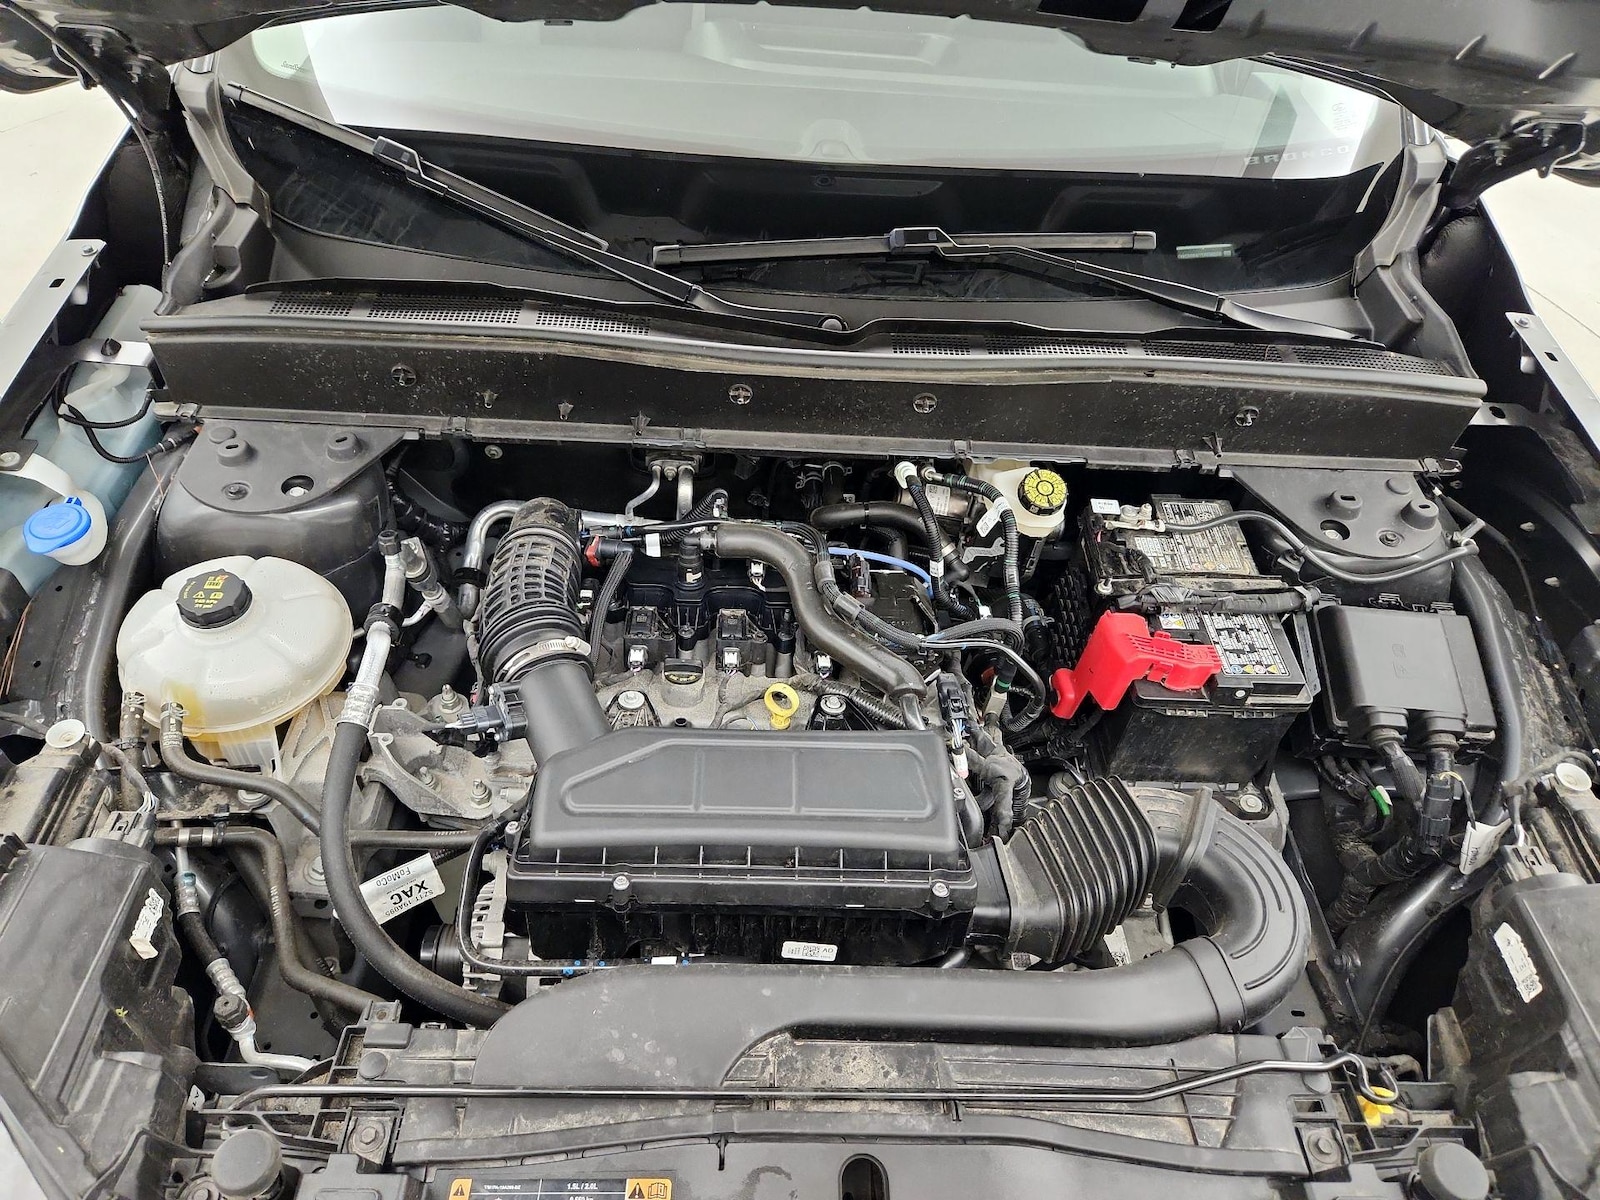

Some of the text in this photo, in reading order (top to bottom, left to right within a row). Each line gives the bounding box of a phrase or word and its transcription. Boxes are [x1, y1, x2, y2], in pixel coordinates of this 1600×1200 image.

[1243, 145, 1349, 165] BRONCO
[376, 866, 411, 886] FoMoCo
[390, 879, 429, 905] XAC
